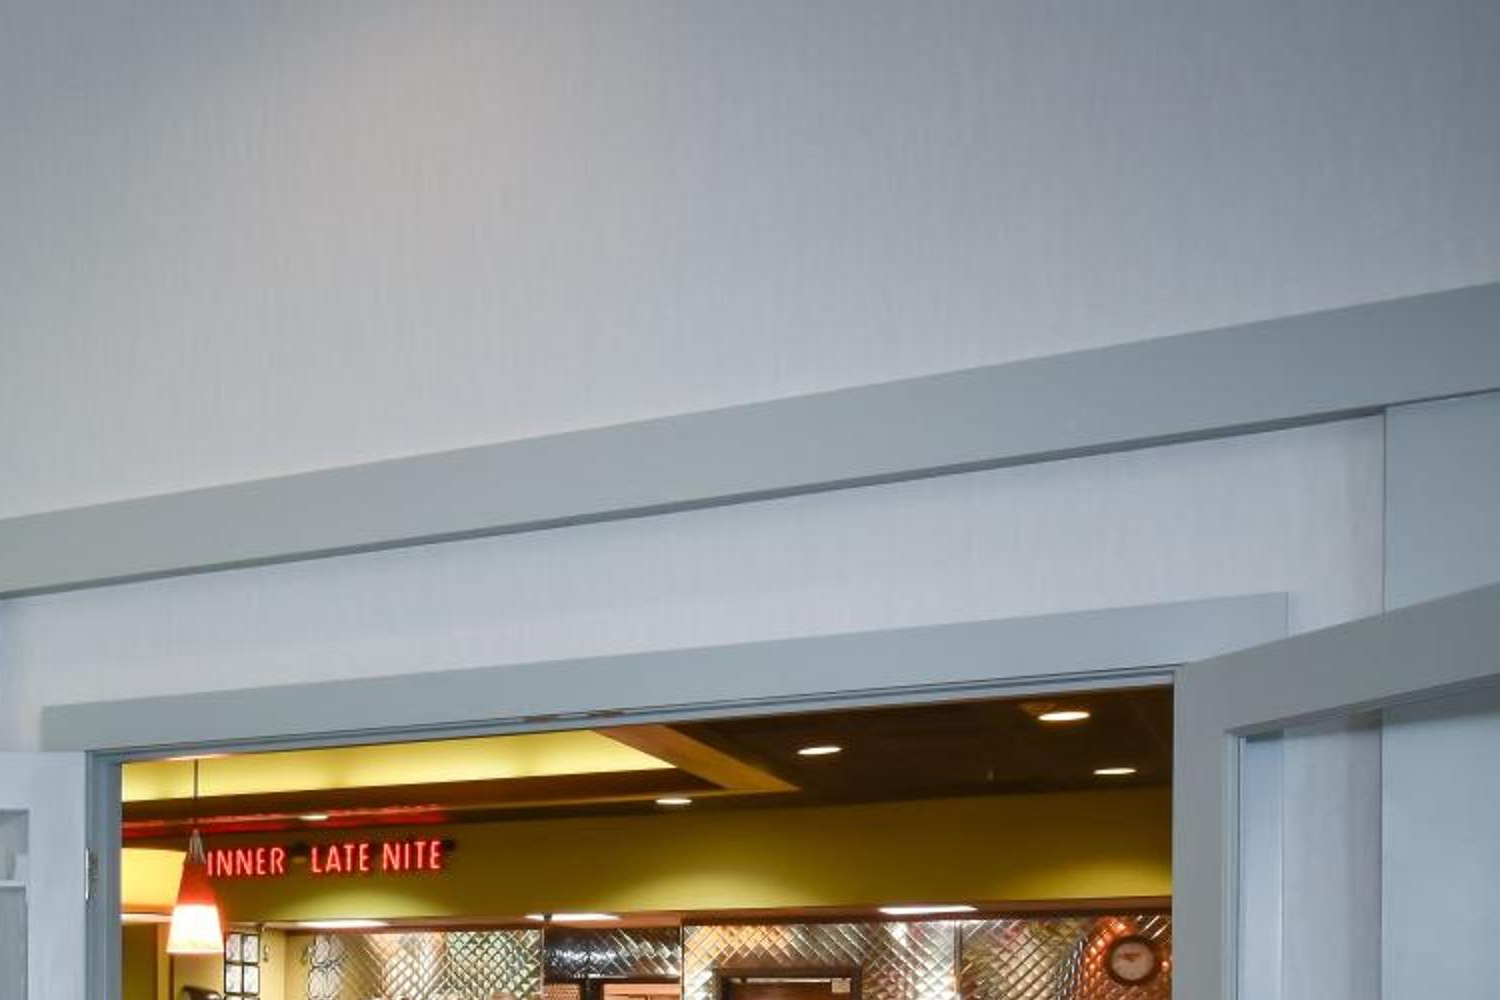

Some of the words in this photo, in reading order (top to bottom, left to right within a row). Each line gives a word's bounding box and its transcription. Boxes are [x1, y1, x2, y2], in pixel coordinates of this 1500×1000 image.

[207, 847, 285, 876] INNER
[311, 842, 369, 873] LATE
[382, 839, 442, 871] NITE
